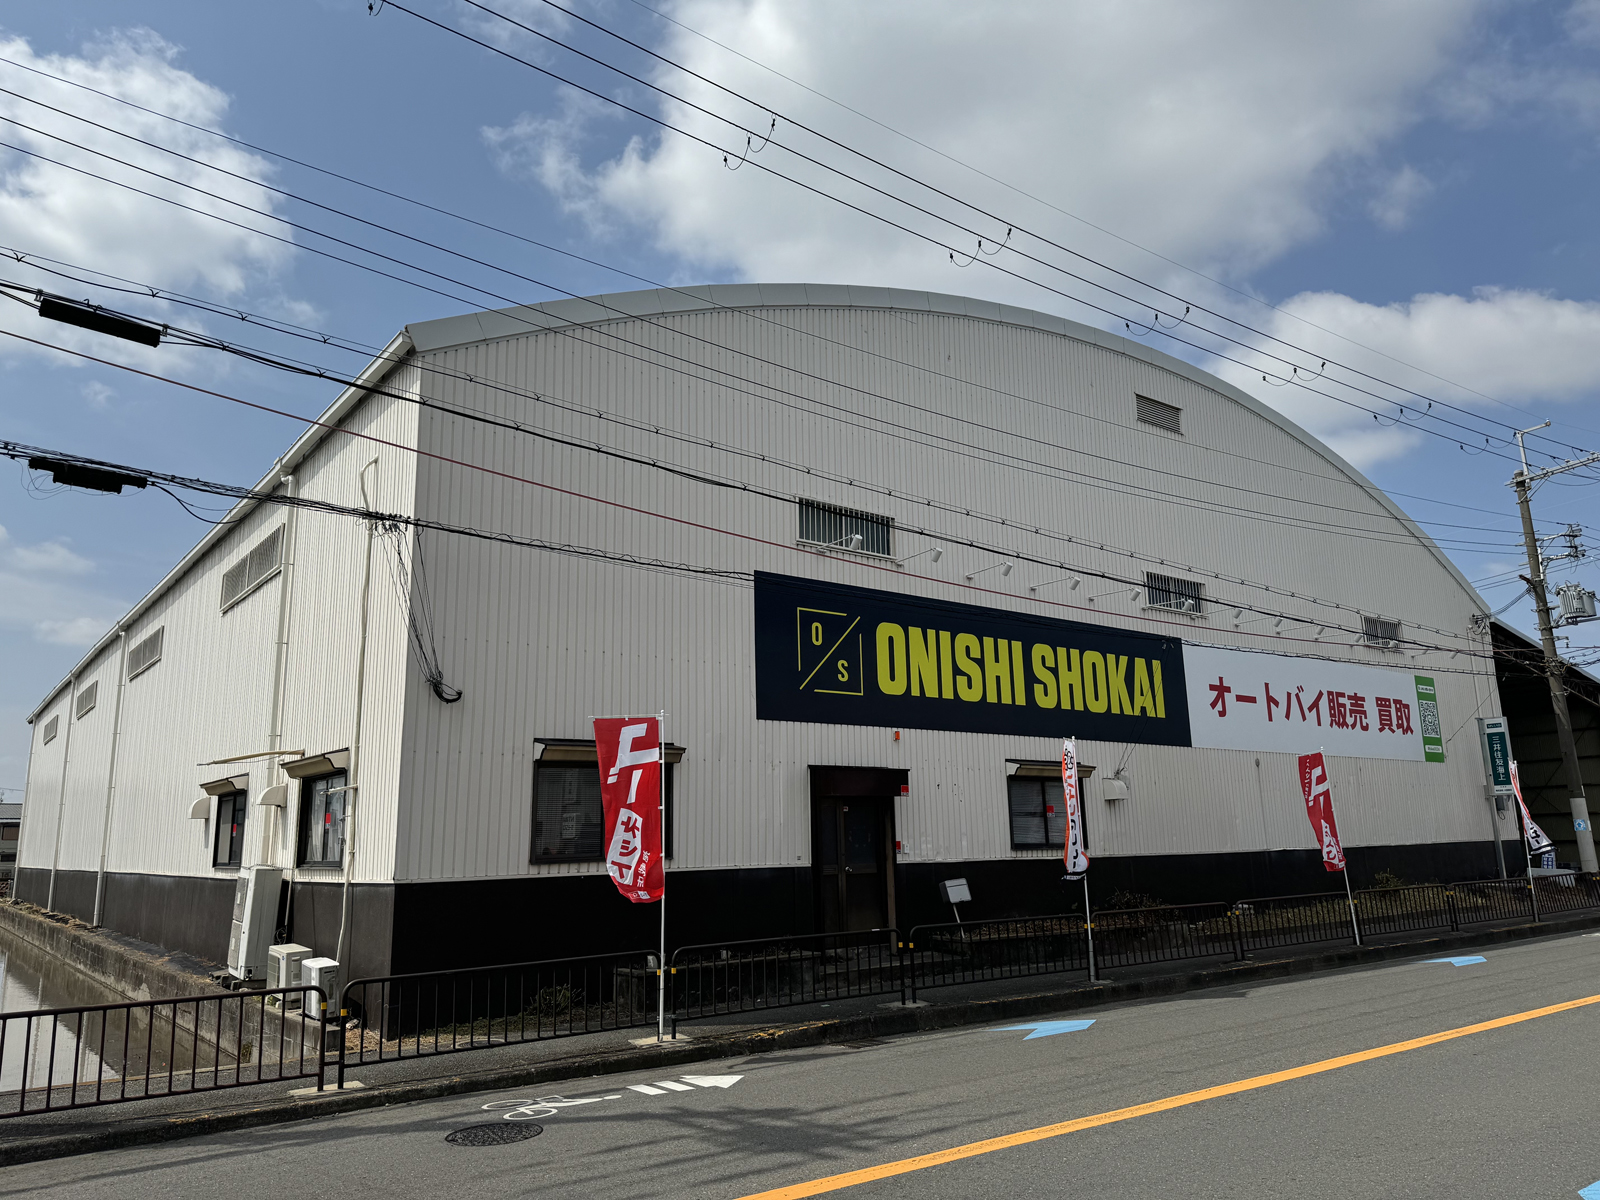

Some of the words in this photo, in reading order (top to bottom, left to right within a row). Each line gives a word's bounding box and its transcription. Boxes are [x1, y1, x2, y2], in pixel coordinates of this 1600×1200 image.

[811, 622, 823, 646] O
[837, 659, 849, 682] S
[875, 621, 1027, 706] ONISHI
[1031, 643, 1166, 719] SHOKAI
[1208, 676, 1370, 732] オートバイ販売
[1375, 696, 1414, 736] 買取
[1491, 735, 1507, 781] 三井住友海上
